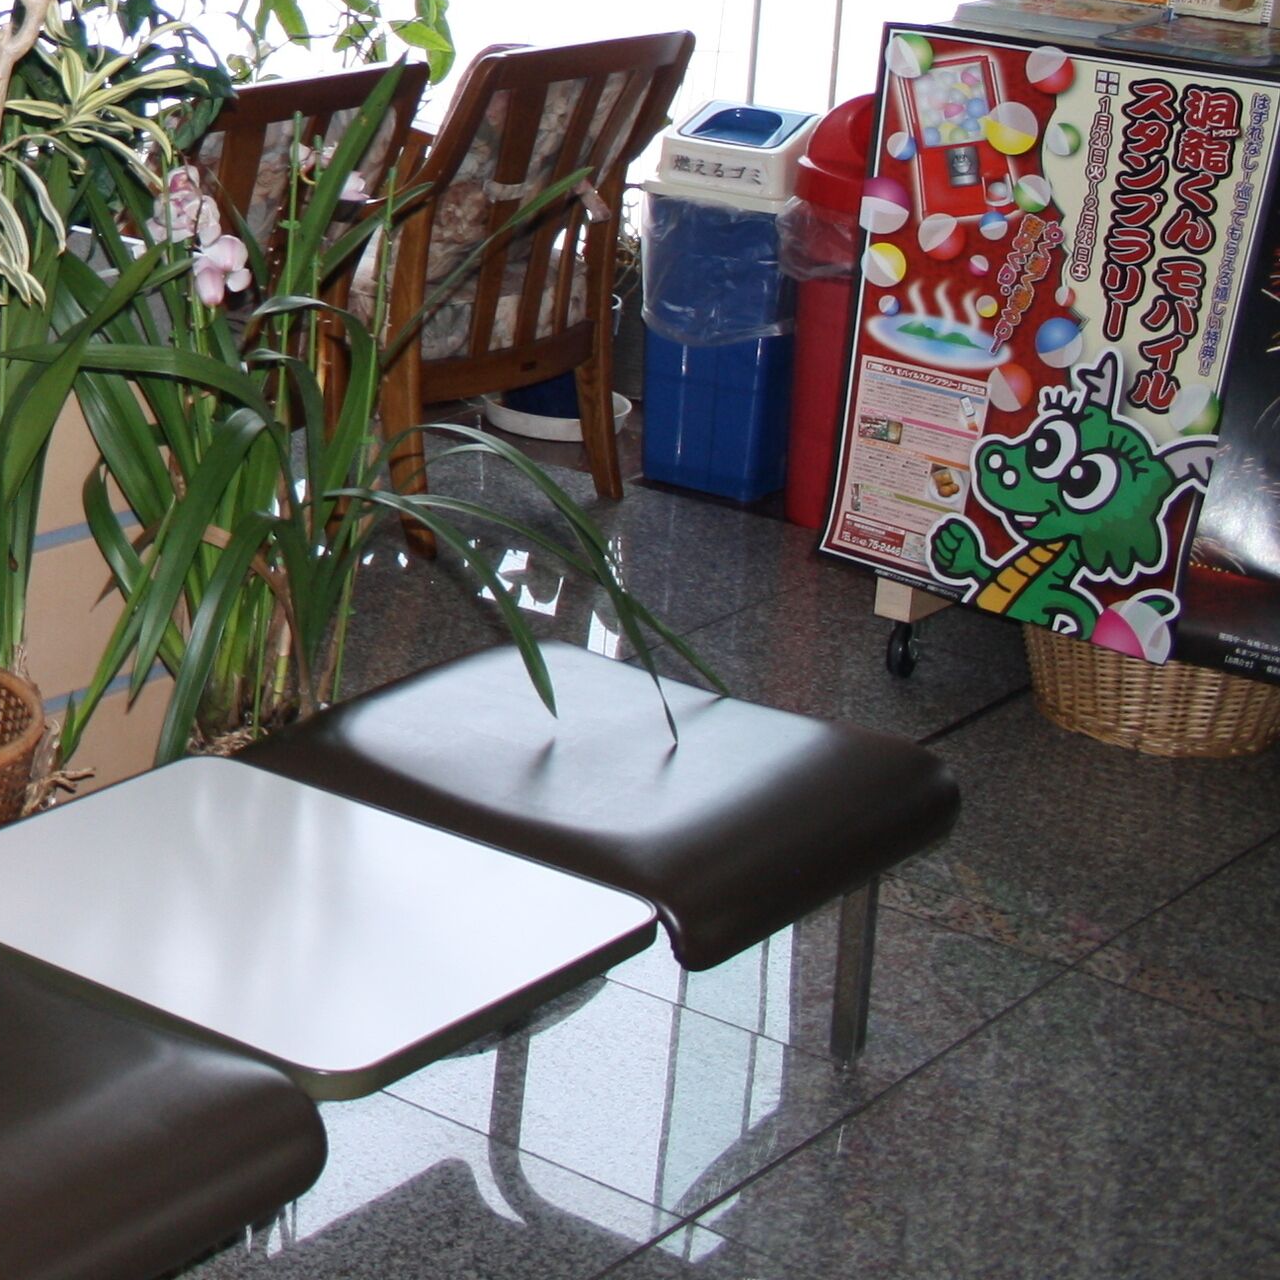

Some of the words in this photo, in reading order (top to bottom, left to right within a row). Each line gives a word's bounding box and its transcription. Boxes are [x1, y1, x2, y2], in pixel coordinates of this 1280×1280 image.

[673, 154, 762, 185] 燃えるゴミ
[1103, 80, 1178, 342] スタンプラリー
[1127, 257, 1206, 413] モバイル
